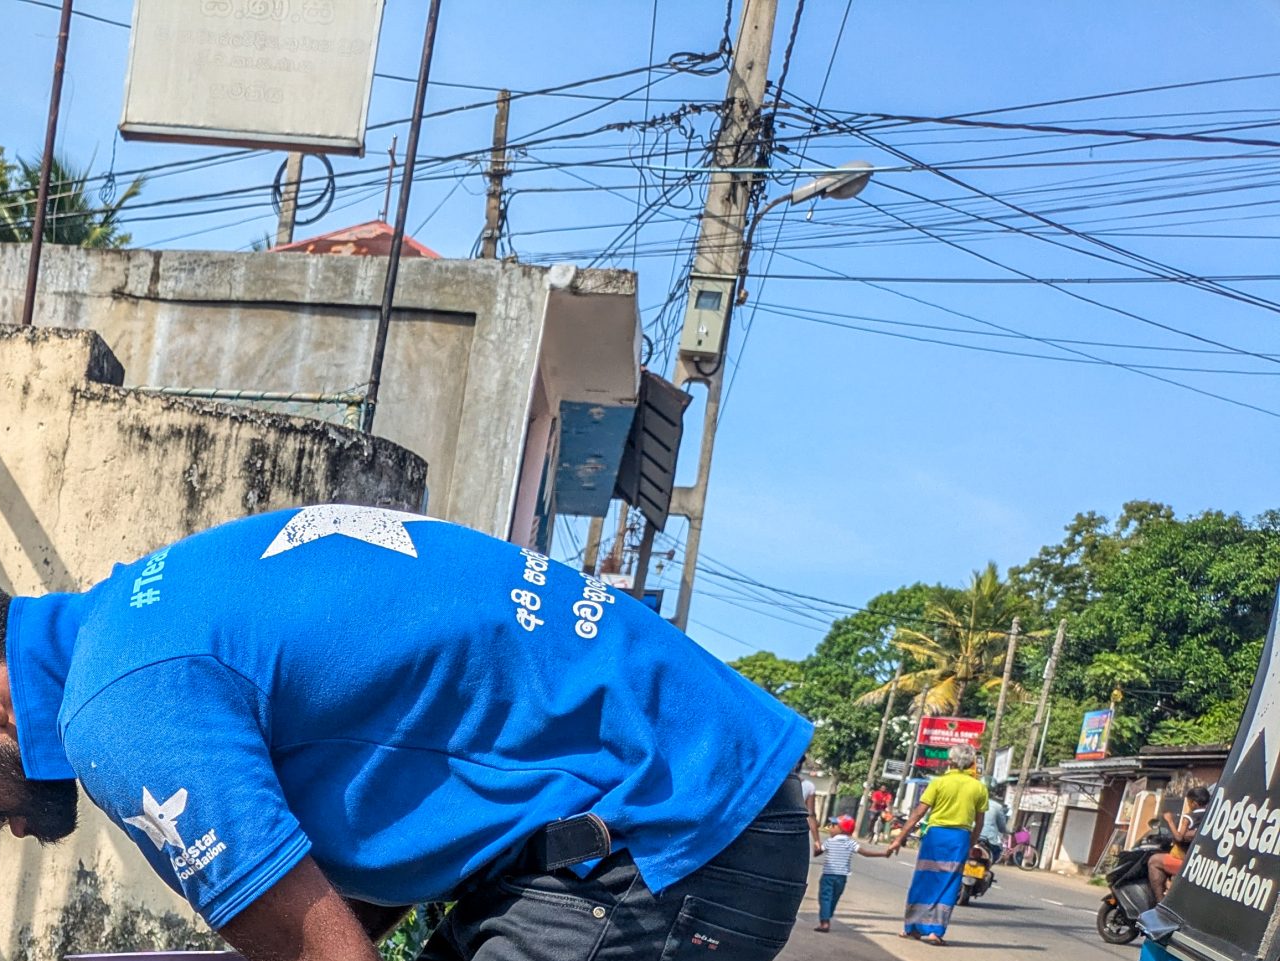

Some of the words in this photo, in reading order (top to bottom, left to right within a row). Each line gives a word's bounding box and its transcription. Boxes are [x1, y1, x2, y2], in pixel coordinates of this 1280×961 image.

[174, 828, 218, 871] ogstar
[178, 840, 227, 880] oundation
[1181, 844, 1274, 912] Foundation
